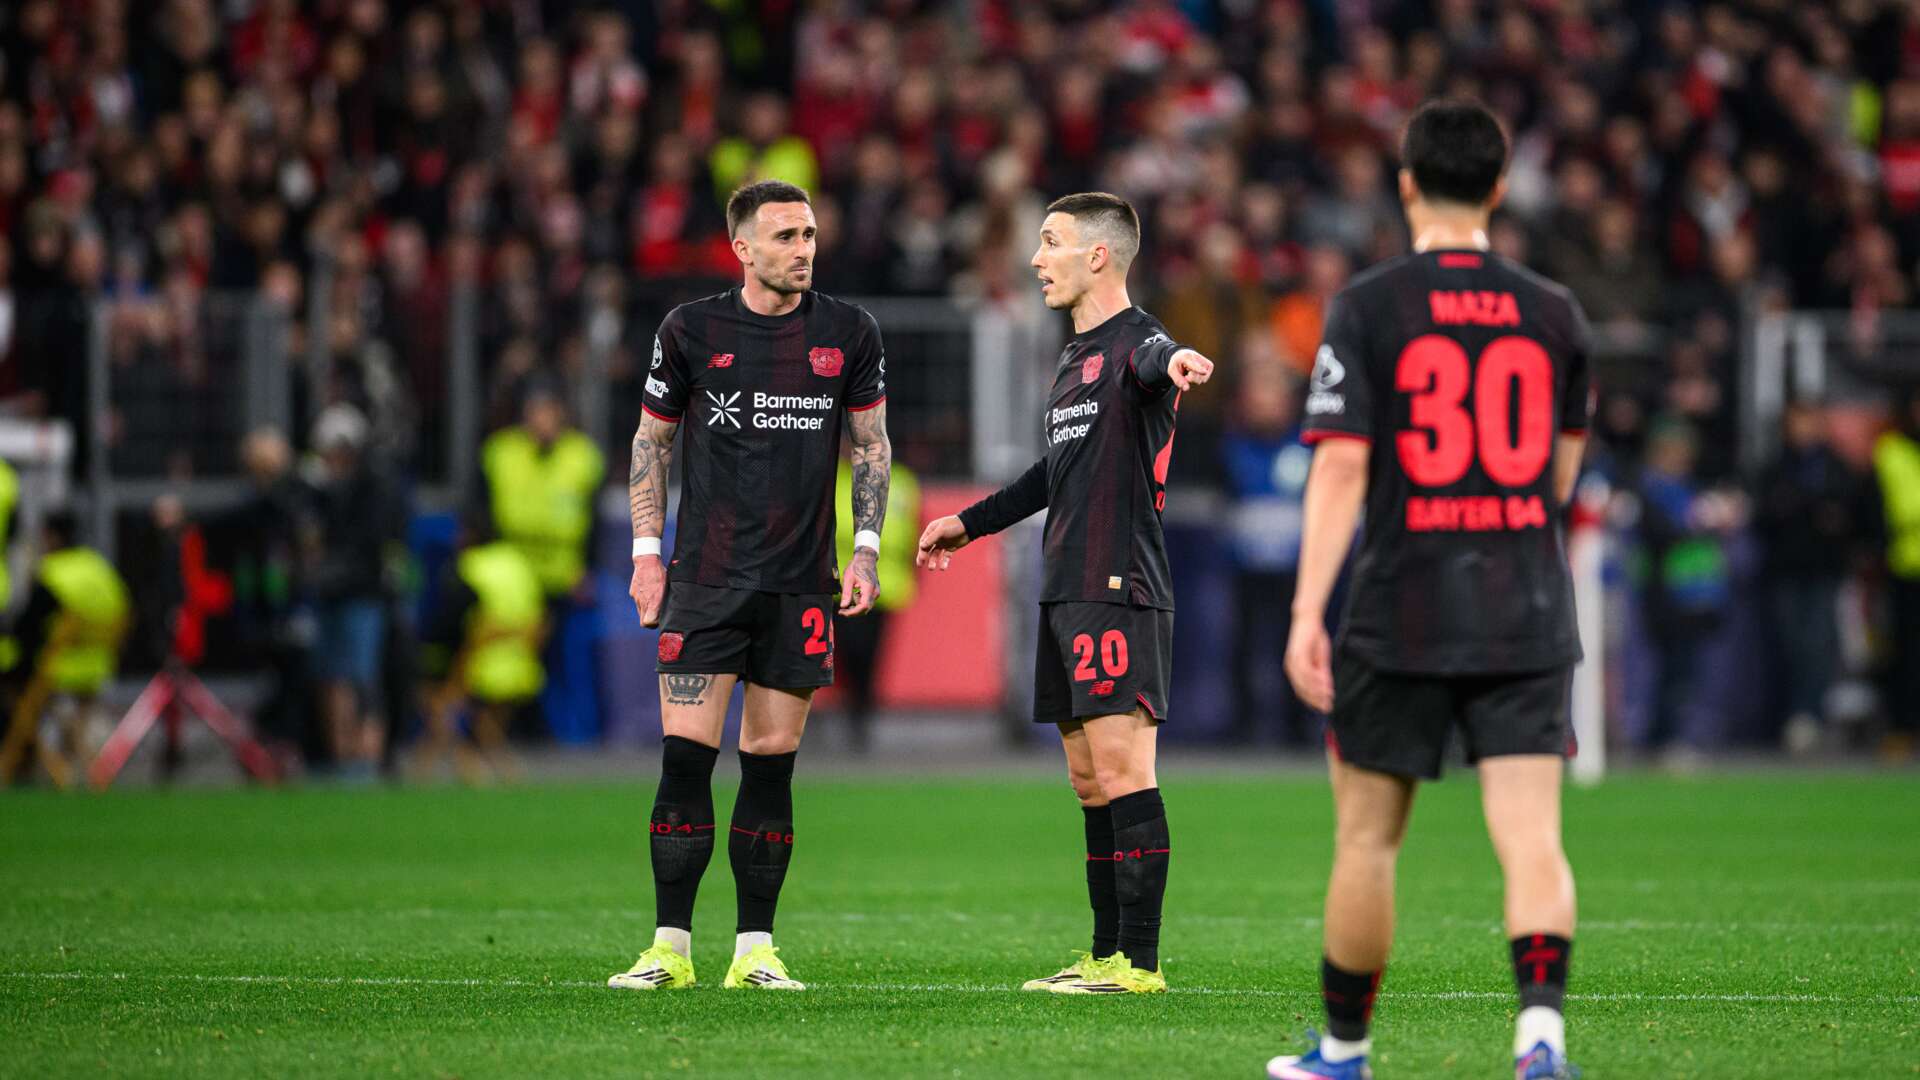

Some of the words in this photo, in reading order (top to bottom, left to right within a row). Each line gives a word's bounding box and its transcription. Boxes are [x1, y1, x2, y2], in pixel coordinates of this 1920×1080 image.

[1428, 289, 1521, 327] MAZA
[753, 392, 834, 410] Barmenia
[1052, 399, 1098, 425] Barmenia
[1395, 334, 1554, 488] 30
[752, 412, 824, 430] Gothaer
[1053, 424, 1090, 444] Gothaer
[1405, 495, 1503, 532] BAYER
[1505, 494, 1547, 530] 04
[802, 607, 834, 655] 2
[1073, 629, 1129, 681] 20
